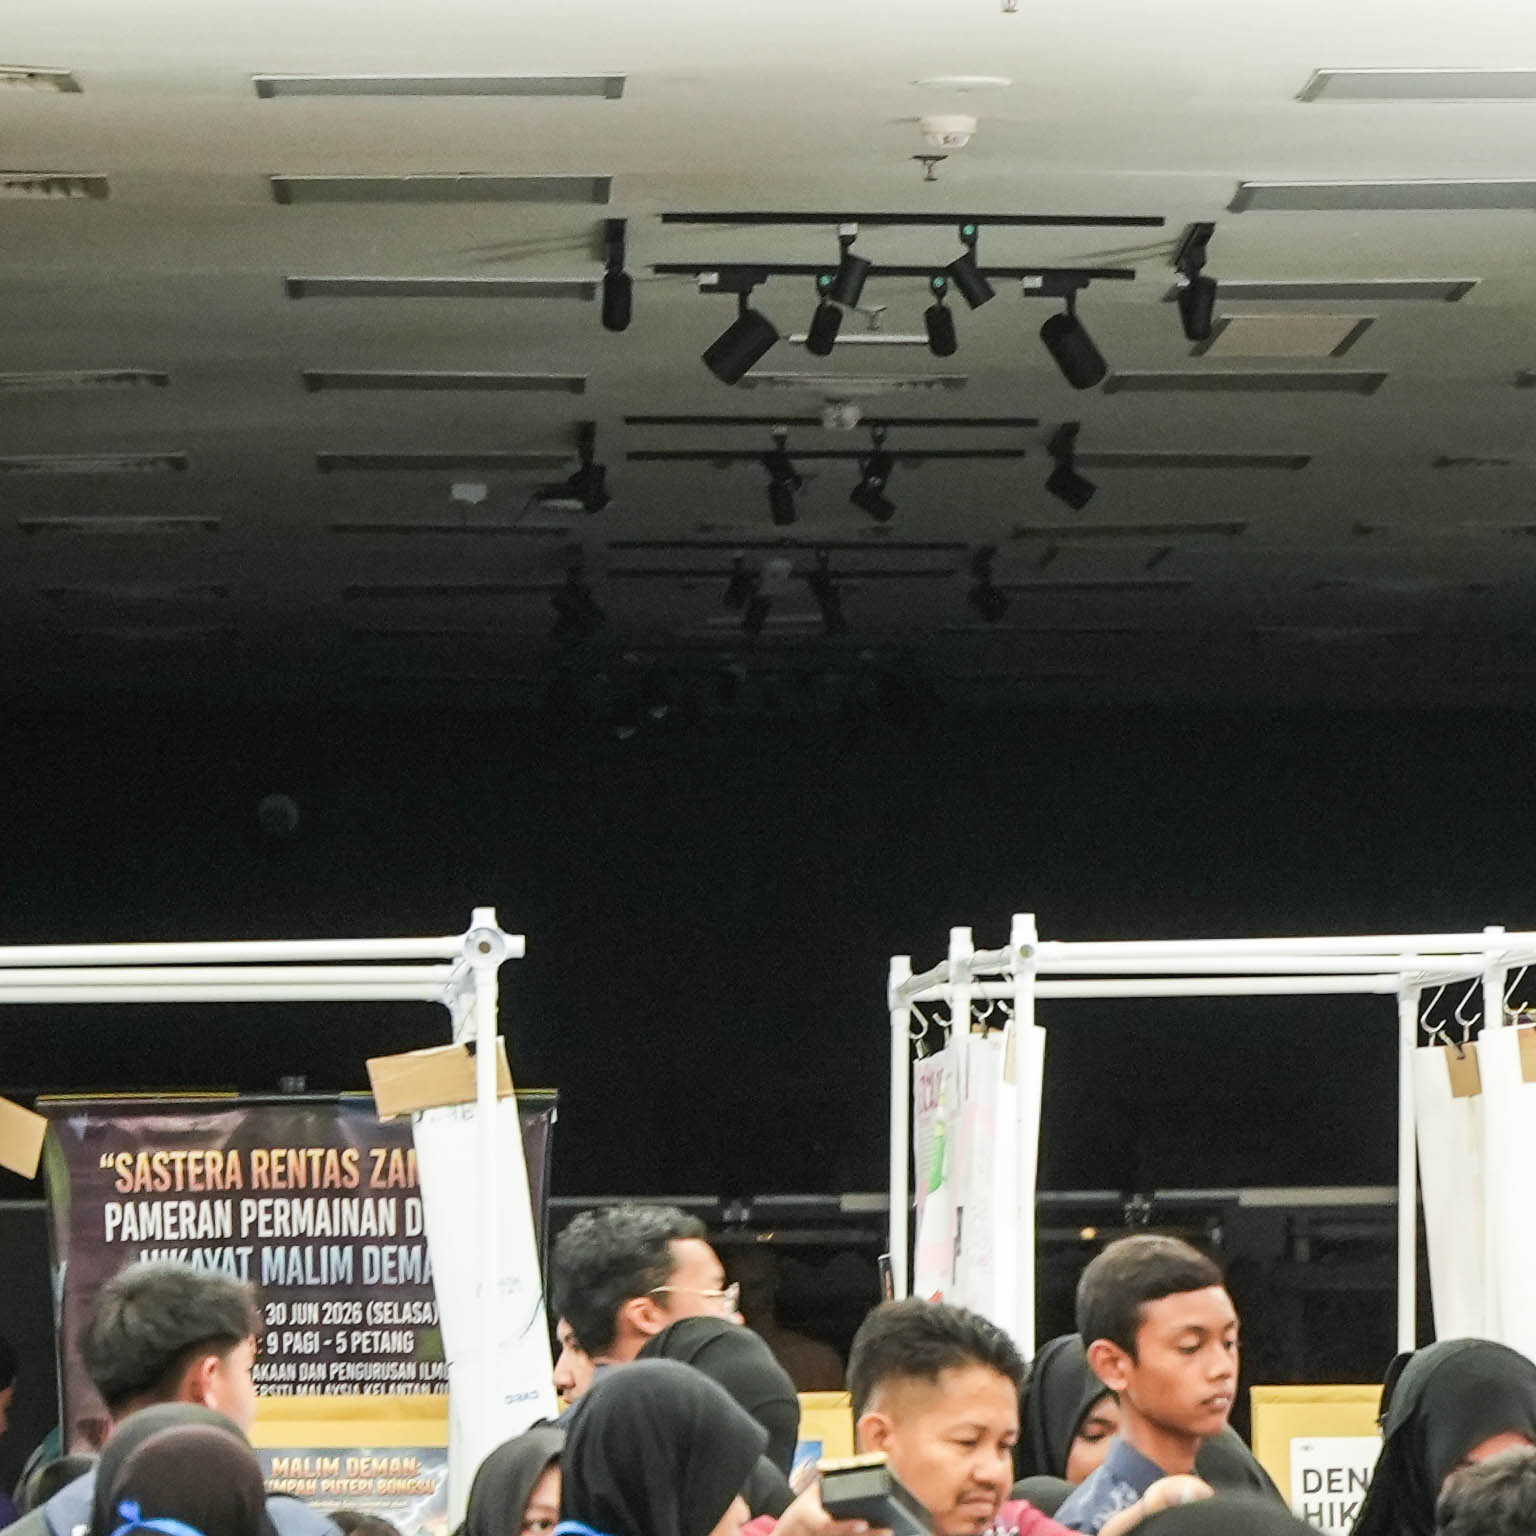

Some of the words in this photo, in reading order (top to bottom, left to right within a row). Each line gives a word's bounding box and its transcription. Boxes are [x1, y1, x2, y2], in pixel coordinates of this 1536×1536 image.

[251, 1148, 360, 1190] RENTAS
[104, 1199, 232, 1242] PAMERAN
[240, 1198, 396, 1239] PERMAINAN
[261, 1245, 354, 1287] MALIM
[265, 1302, 287, 1326] 30
[289, 1301, 319, 1326] JUN
[321, 1301, 363, 1326] 2026
[366, 1300, 440, 1327] (SELASA)
[266, 1331, 279, 1355] 9
[282, 1331, 320, 1354] PAGI
[335, 1331, 348, 1354] 5
[351, 1330, 415, 1354] PETANG
[299, 1362, 327, 1381] DAN
[329, 1361, 416, 1381] PENGURUSAN
[271, 1456, 340, 1478] MALIM
[1303, 1467, 1368, 1494] DEN
[1303, 1502, 1358, 1528] HIK
